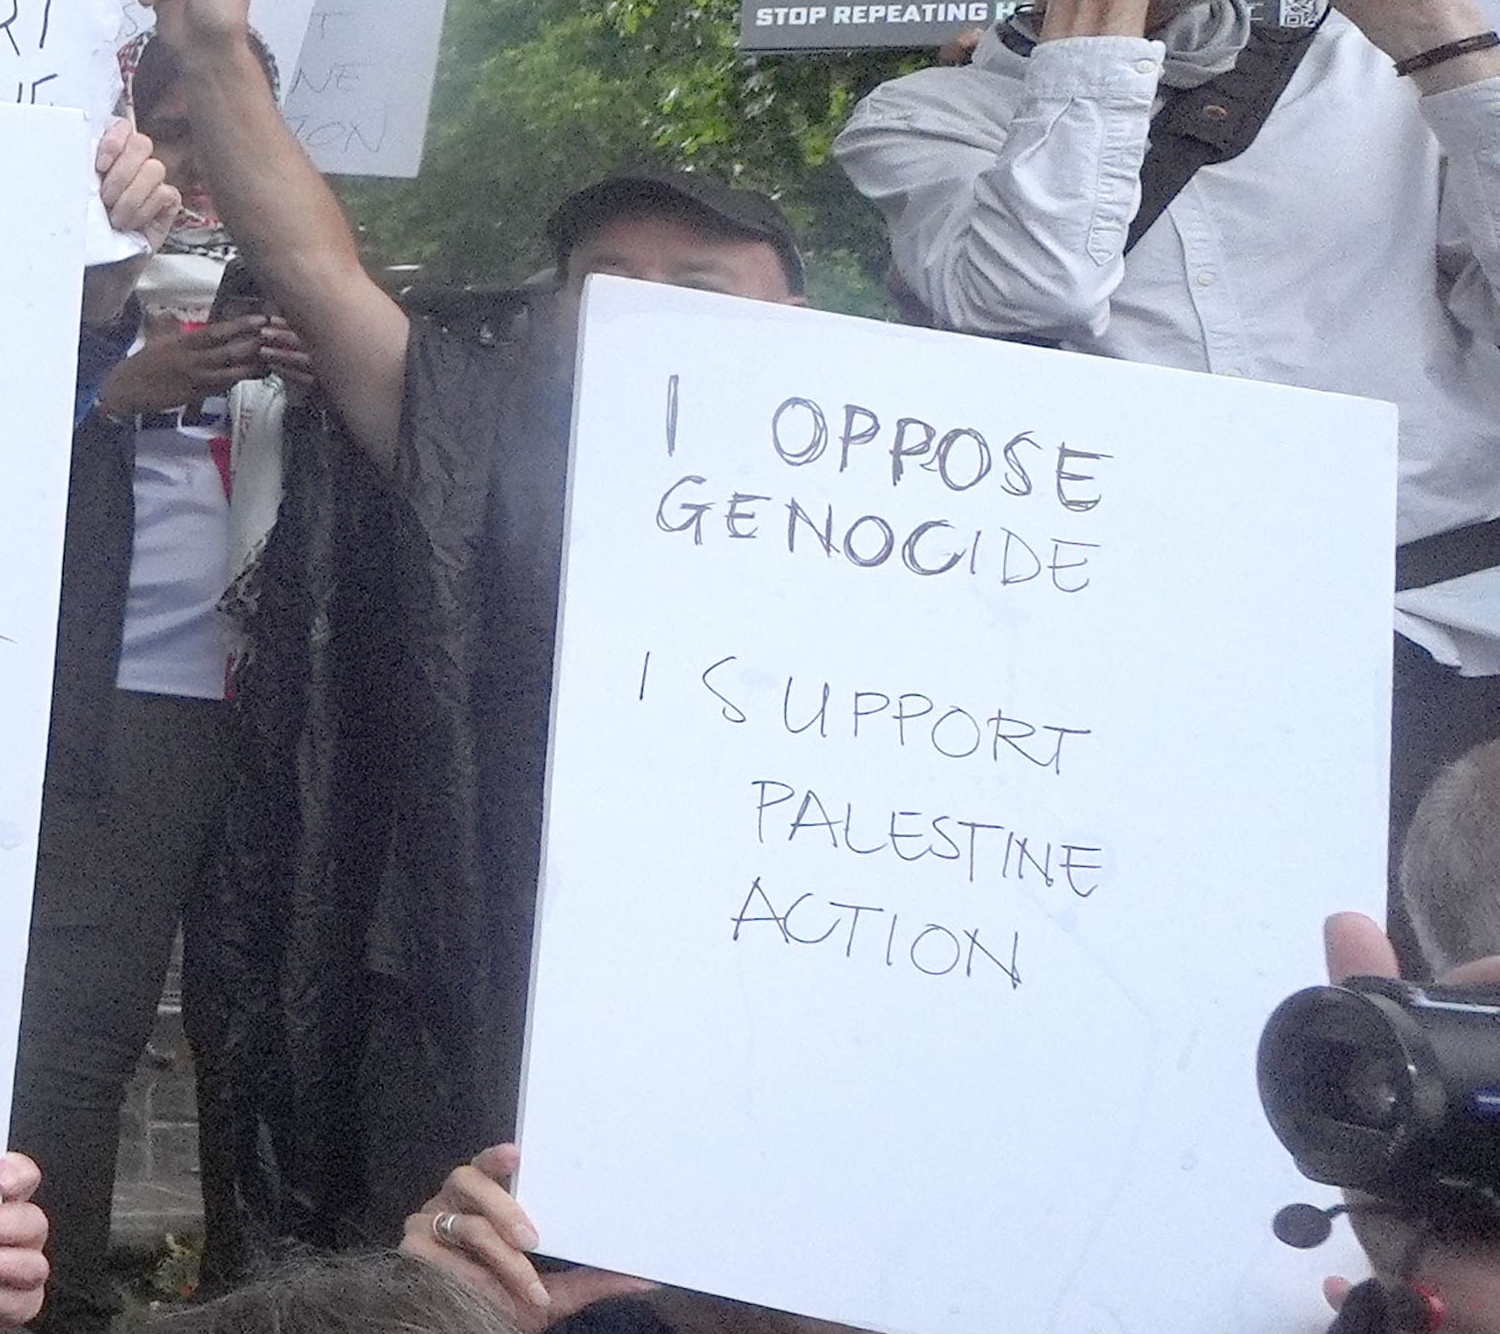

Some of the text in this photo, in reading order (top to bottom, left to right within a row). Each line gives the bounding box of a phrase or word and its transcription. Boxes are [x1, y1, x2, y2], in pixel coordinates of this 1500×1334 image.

[755, 4, 826, 27] STOP
[832, 1, 989, 25] REPEATING
[666, 374, 1114, 510] I OPPOSE
[655, 475, 1099, 594] GENOCIDE
[639, 650, 1091, 777] I SUPPORT
[752, 779, 1102, 899] PALESTINE
[732, 878, 1022, 989] ACTION
